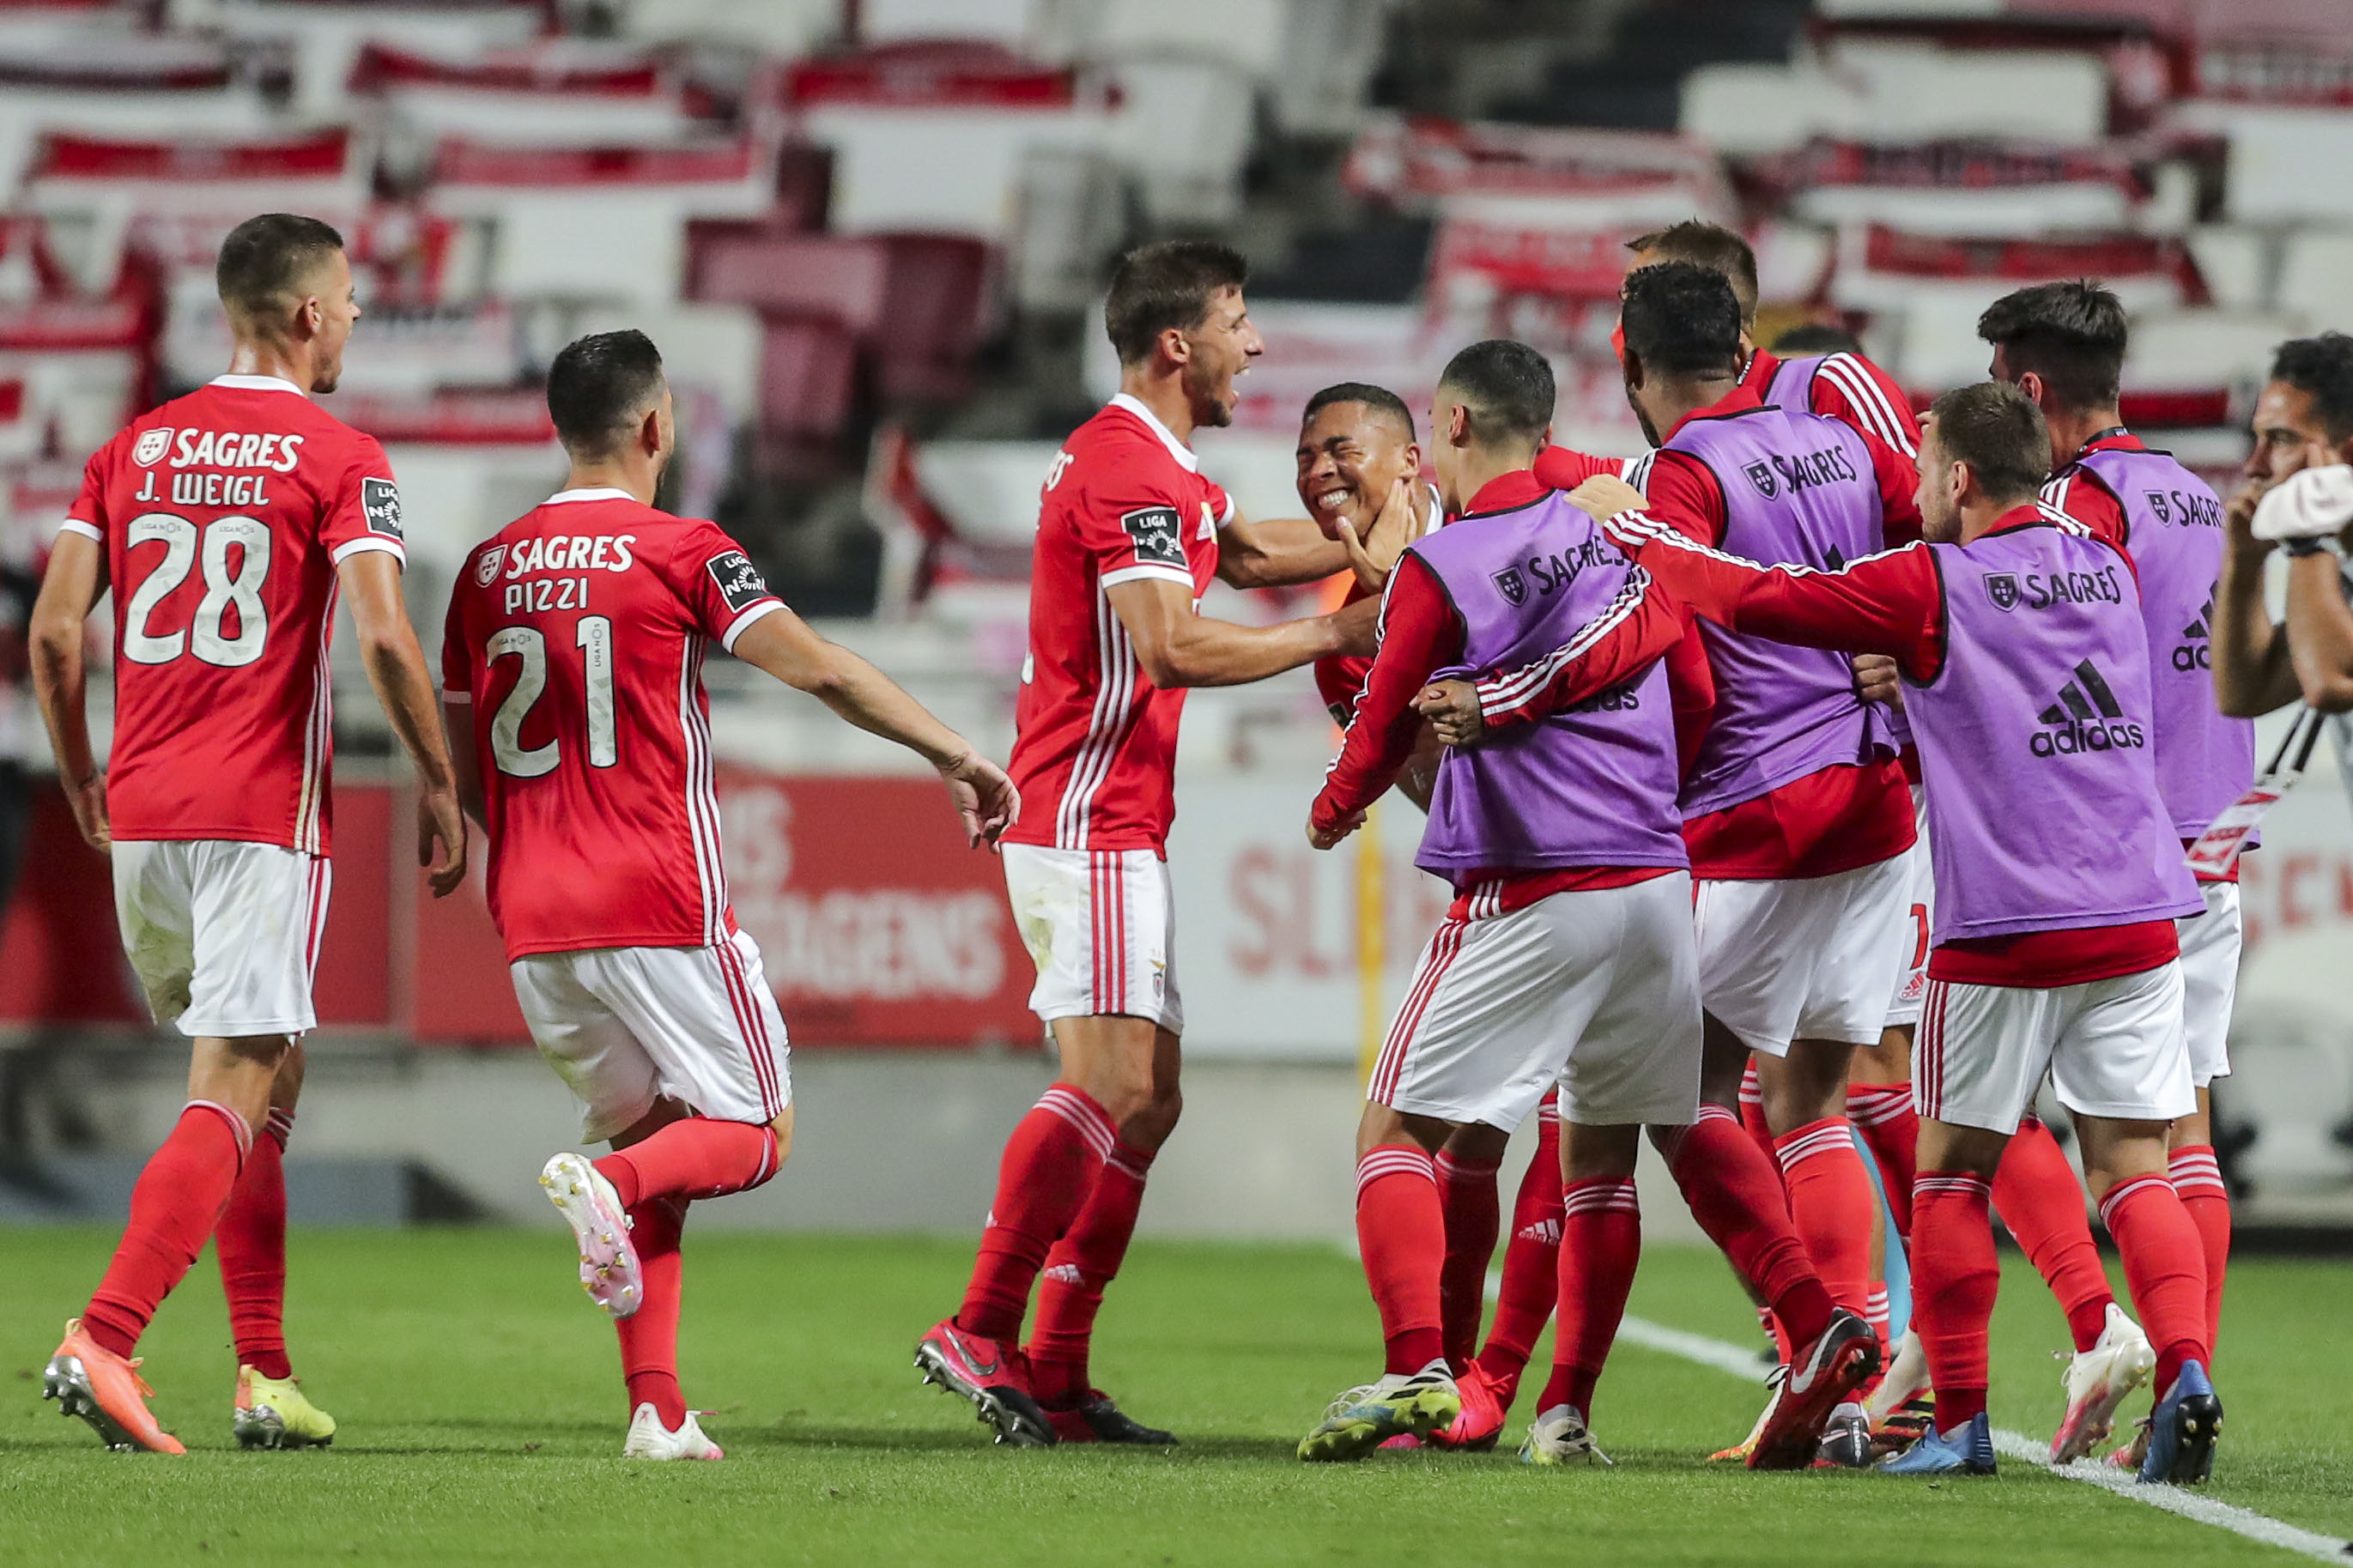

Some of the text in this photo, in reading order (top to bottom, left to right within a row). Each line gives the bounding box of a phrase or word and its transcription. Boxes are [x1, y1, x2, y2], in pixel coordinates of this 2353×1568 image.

[170, 427, 304, 472] SAGRES
[1772, 445, 1857, 495] SAGRES
[135, 471, 270, 506] J. WEIGL
[1138, 516, 1167, 530] LIGA
[505, 534, 636, 580] SAGRES
[123, 512, 272, 668] 28
[504, 577, 590, 615] PIZZI
[2026, 565, 2121, 610] SAGRES
[485, 614, 619, 779] 21
[2029, 718, 2144, 759] adidas
